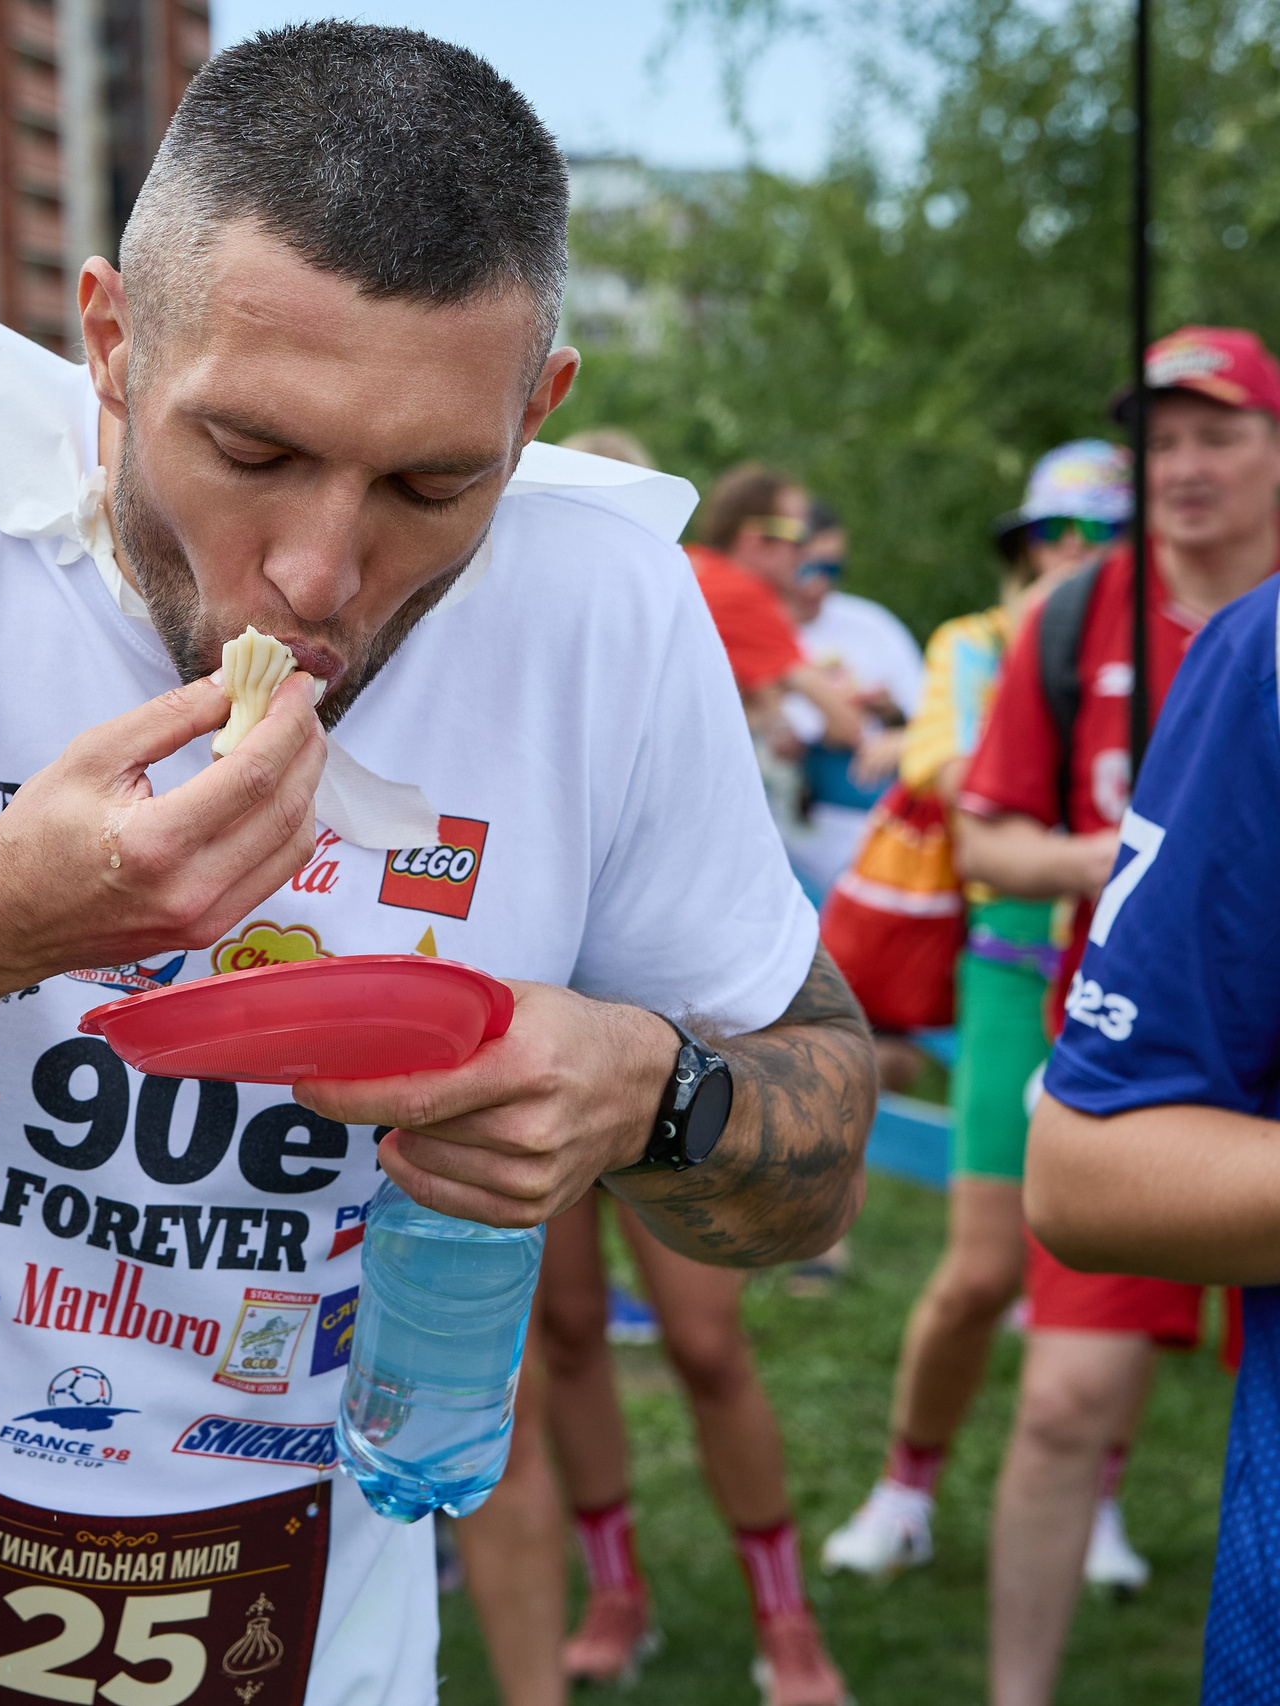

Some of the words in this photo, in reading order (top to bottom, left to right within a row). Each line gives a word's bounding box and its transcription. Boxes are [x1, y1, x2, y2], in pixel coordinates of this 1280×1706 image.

[389, 844, 477, 883] LEGO
[12, 1258, 221, 1357] Marlboro
[13, 1446, 68, 1464] WORLD
[74, 1458, 104, 1469] CUP
[101, 1447, 132, 1463] 98
[169, 1540, 241, 1580] МИЛЯ
